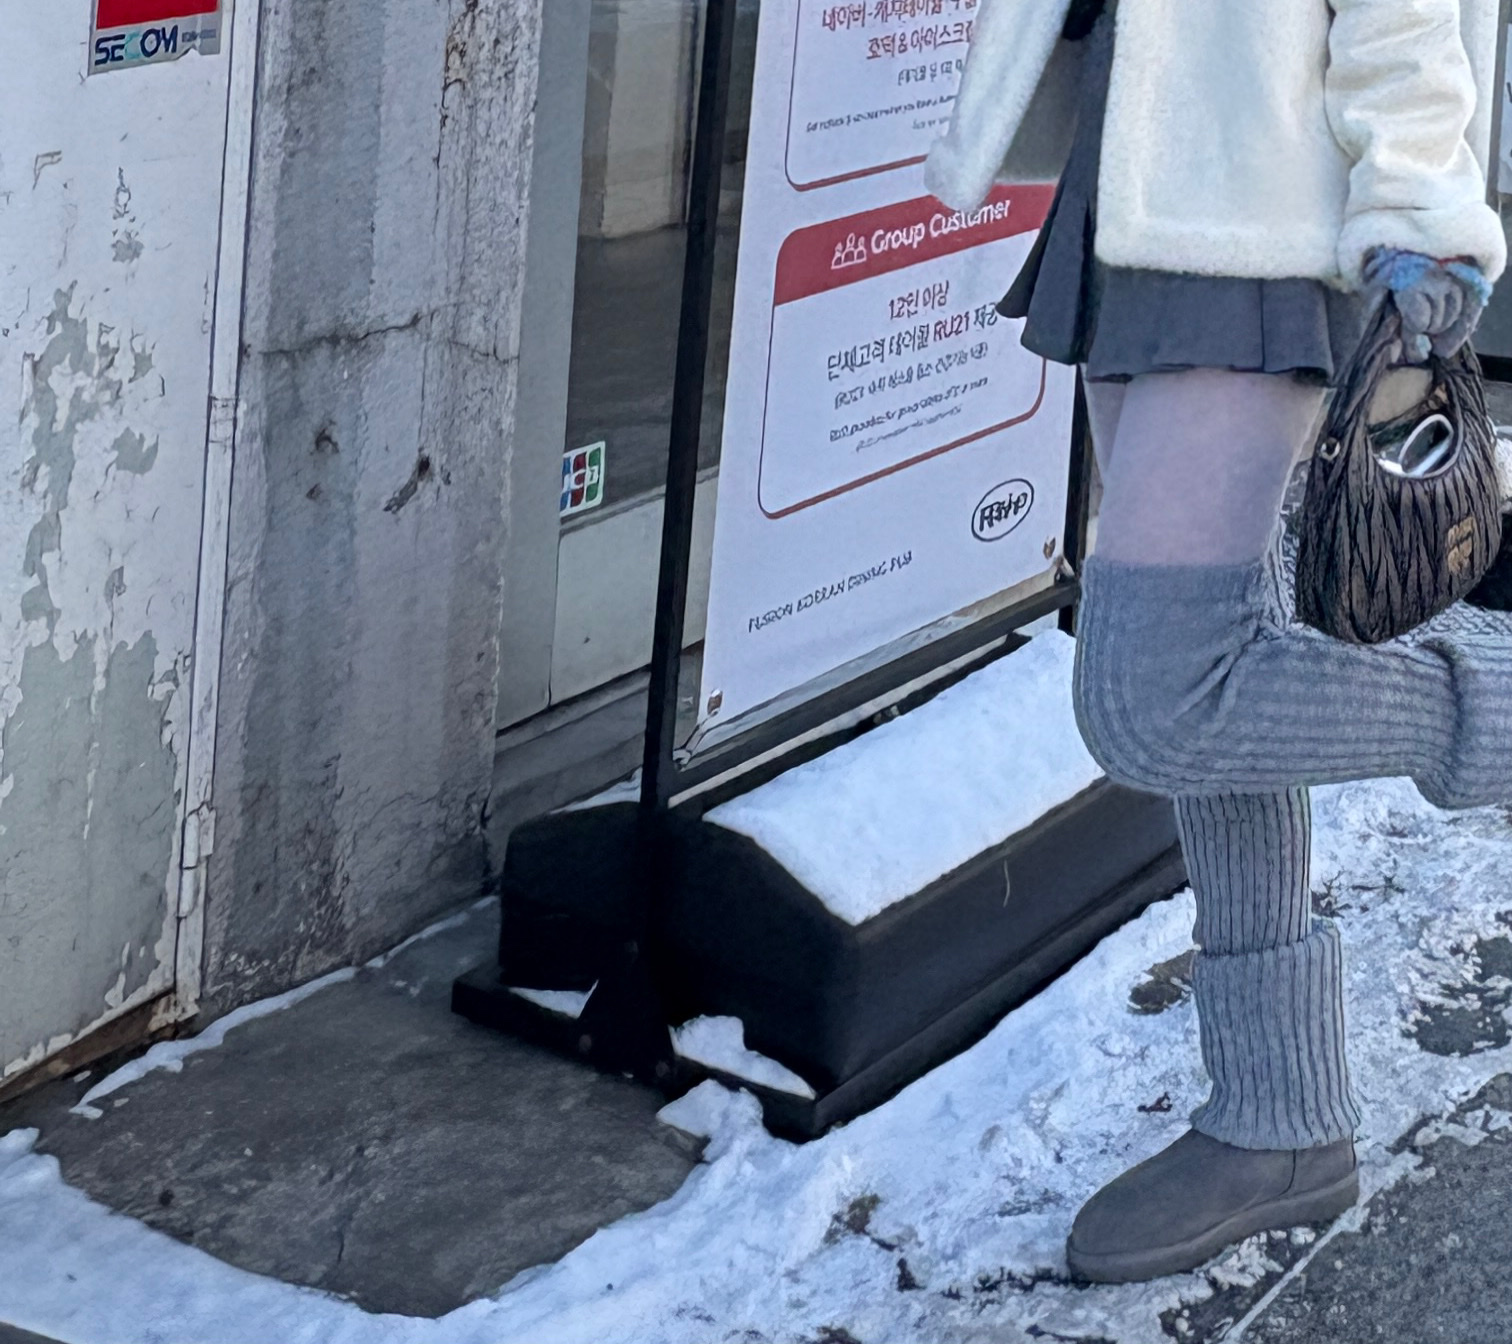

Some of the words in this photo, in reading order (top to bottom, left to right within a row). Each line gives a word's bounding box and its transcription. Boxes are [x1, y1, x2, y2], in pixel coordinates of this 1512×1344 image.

[94, 24, 179, 67] SECOM
[870, 222, 926, 255] Group
[922, 279, 950, 311] 이상
[933, 310, 971, 343] RU21
